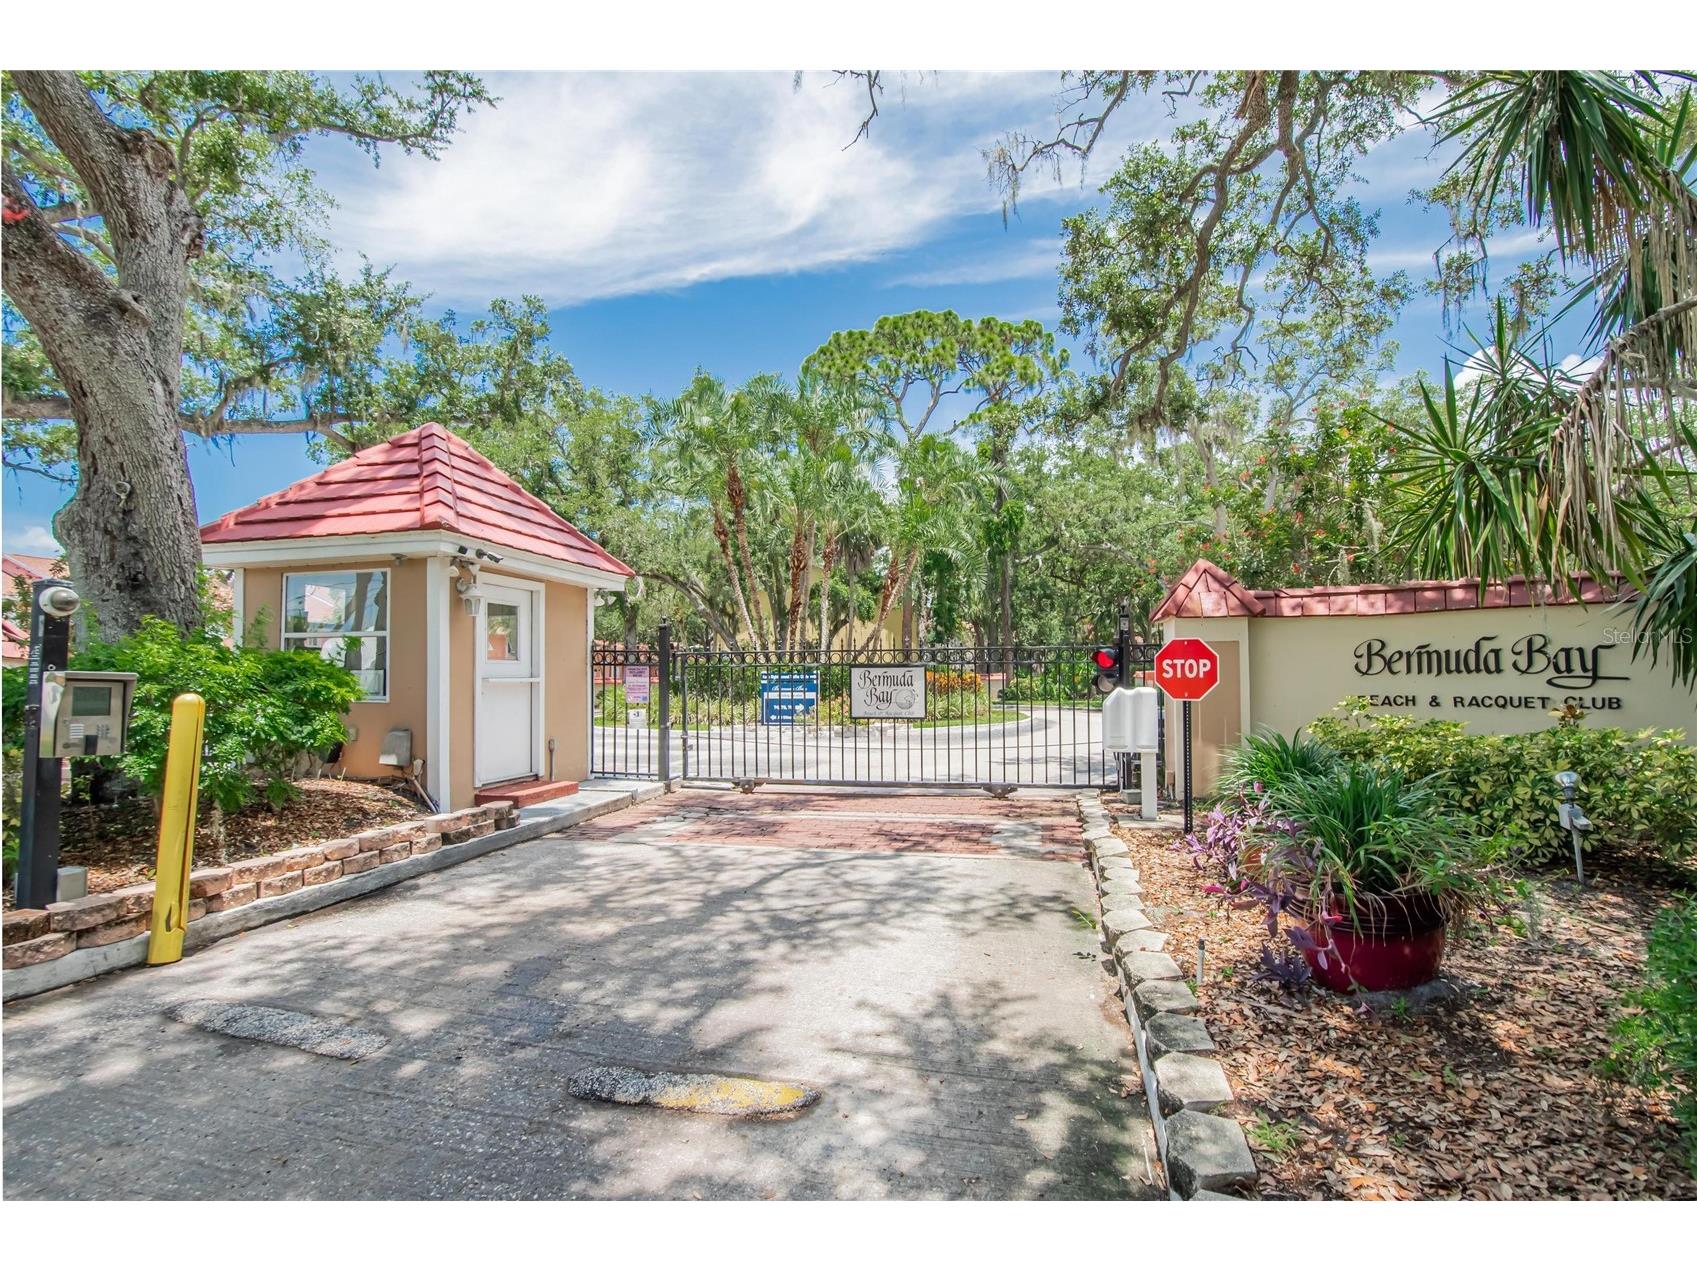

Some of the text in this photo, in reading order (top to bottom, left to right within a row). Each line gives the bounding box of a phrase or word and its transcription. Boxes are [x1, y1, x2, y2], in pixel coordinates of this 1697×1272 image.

[1162, 658, 1211, 678] STOP
[1353, 633, 1631, 690] Bermuda Bay
[857, 669, 914, 689] Bermuda
[863, 687, 898, 711] Bay
[1358, 695, 1622, 709] EACH & RACQUET CLUB
